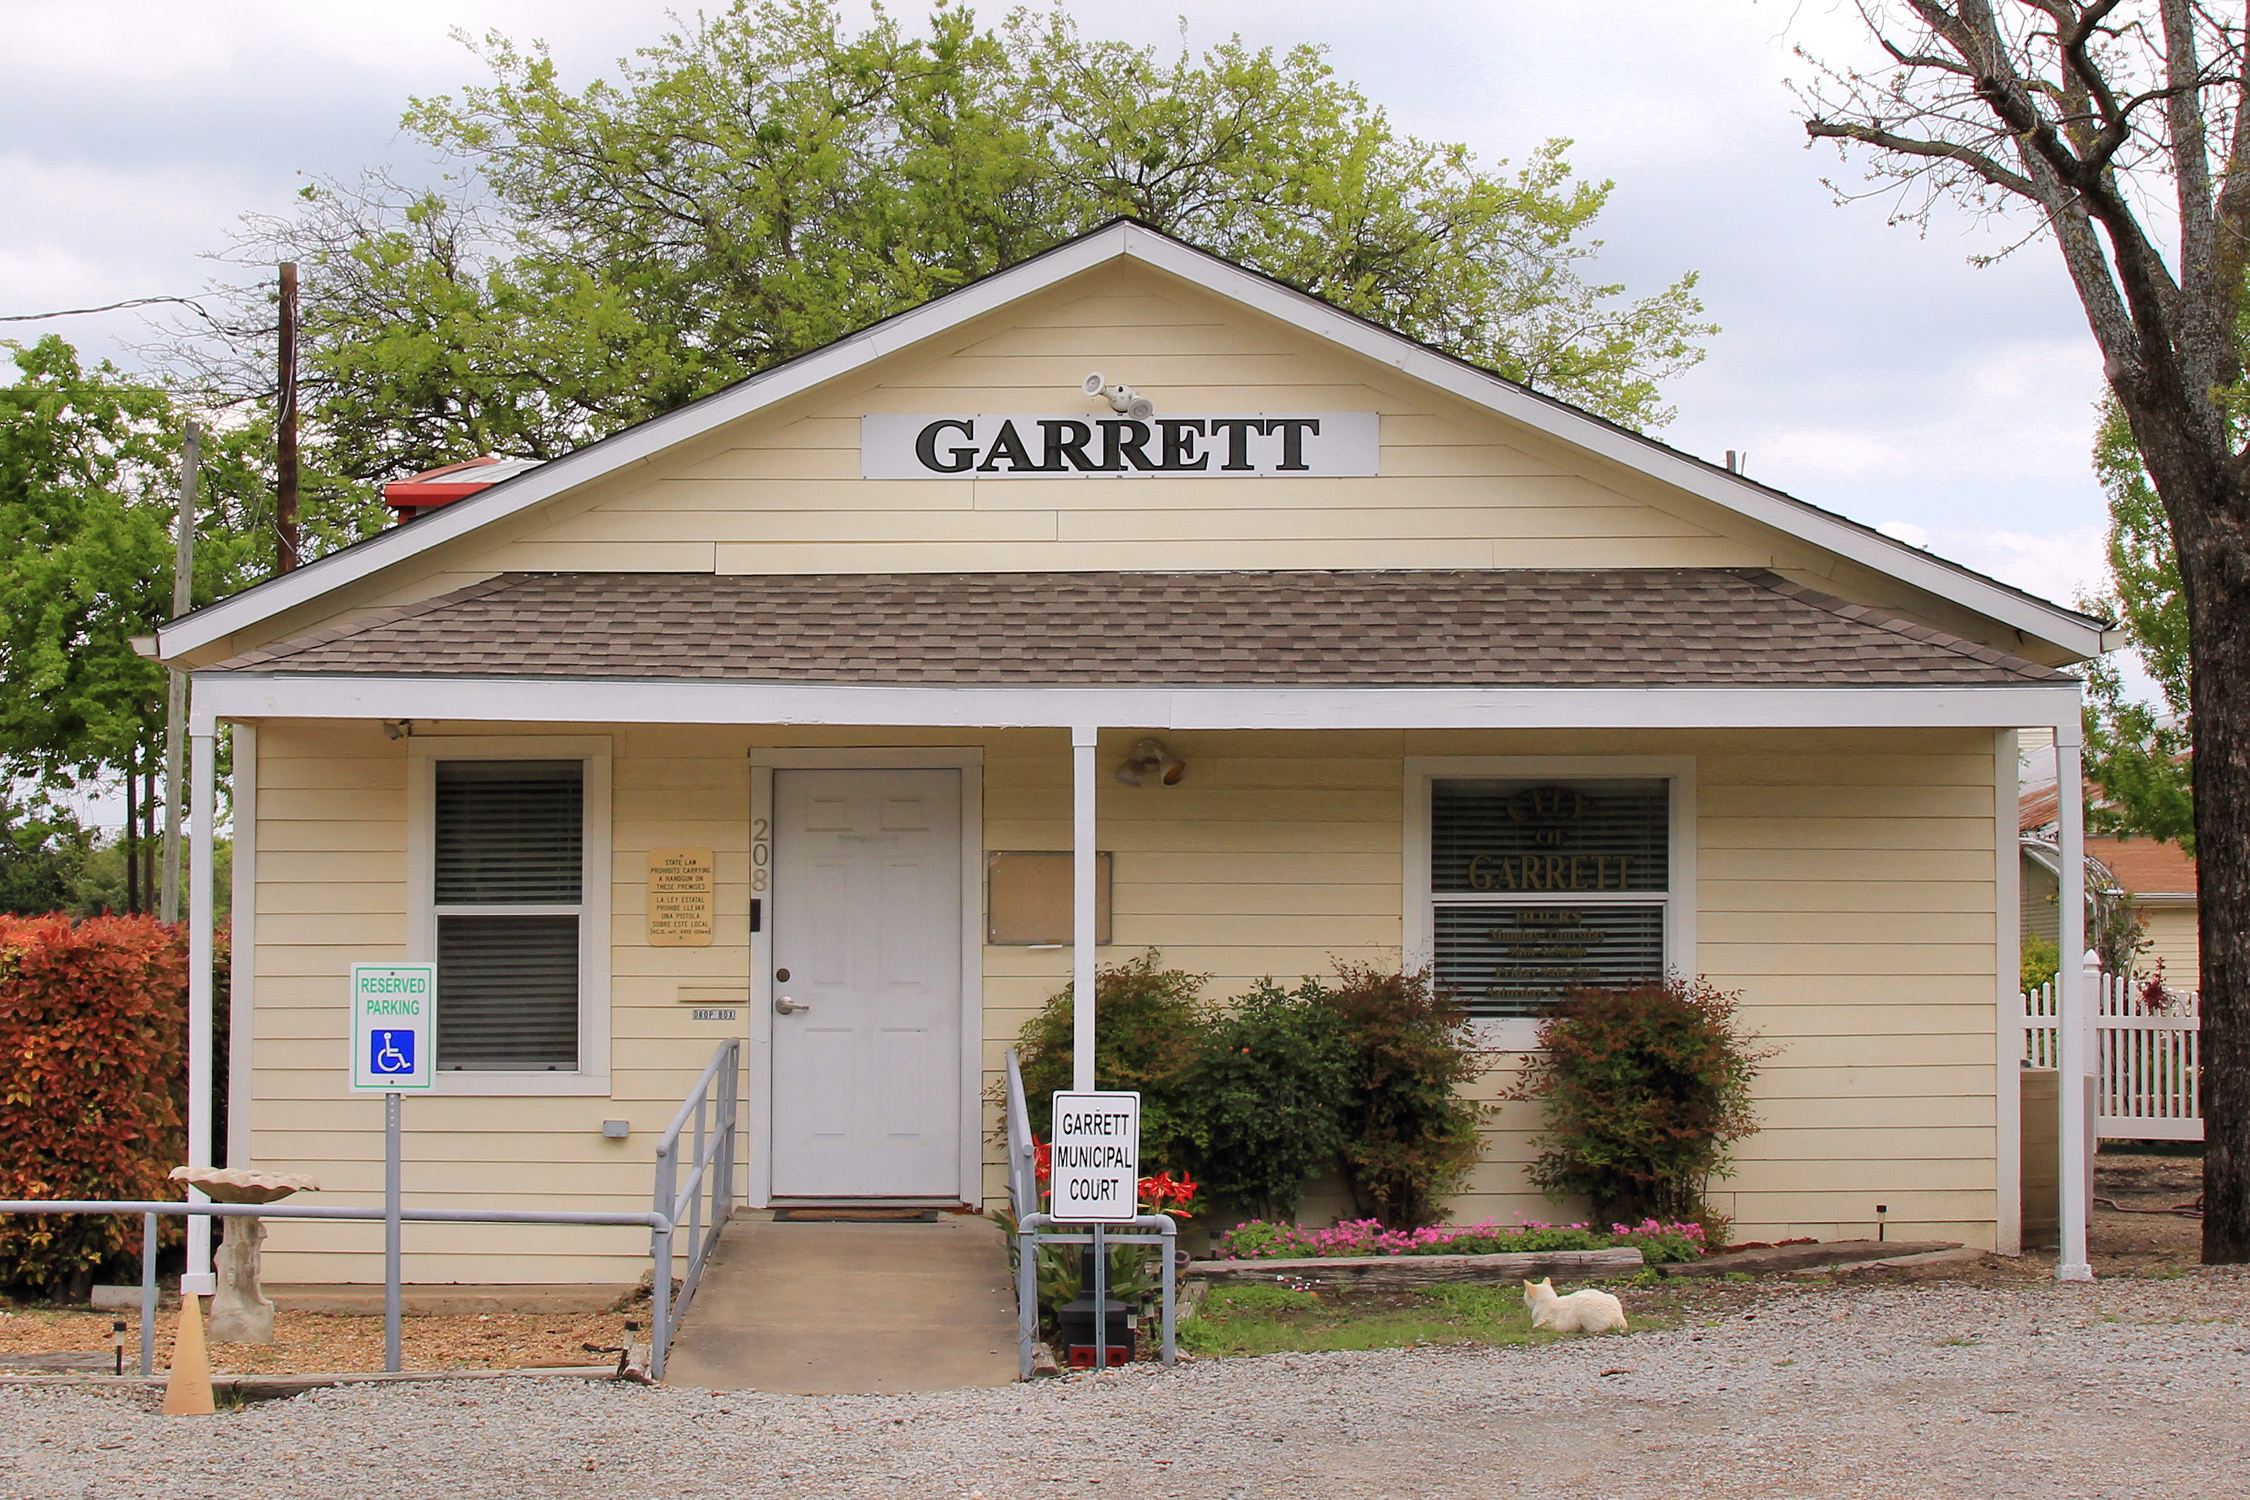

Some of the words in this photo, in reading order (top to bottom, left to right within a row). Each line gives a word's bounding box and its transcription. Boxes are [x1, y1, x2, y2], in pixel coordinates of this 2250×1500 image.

[915, 418, 1320, 473] GARRETT
[1506, 786, 1594, 821] CITY
[1535, 829, 1568, 846] OF
[752, 818, 769, 892] 208
[1468, 854, 1634, 890] GARRETT
[361, 977, 426, 994] RESERVED
[366, 1000, 420, 1016] PARKING
[694, 1010, 713, 1019] DROP
[719, 1010, 734, 1019] BOX
[1063, 1113, 1129, 1135] GARRETT
[1057, 1146, 1132, 1168] MUNICIPAL
[1070, 1178, 1119, 1201] COURT
